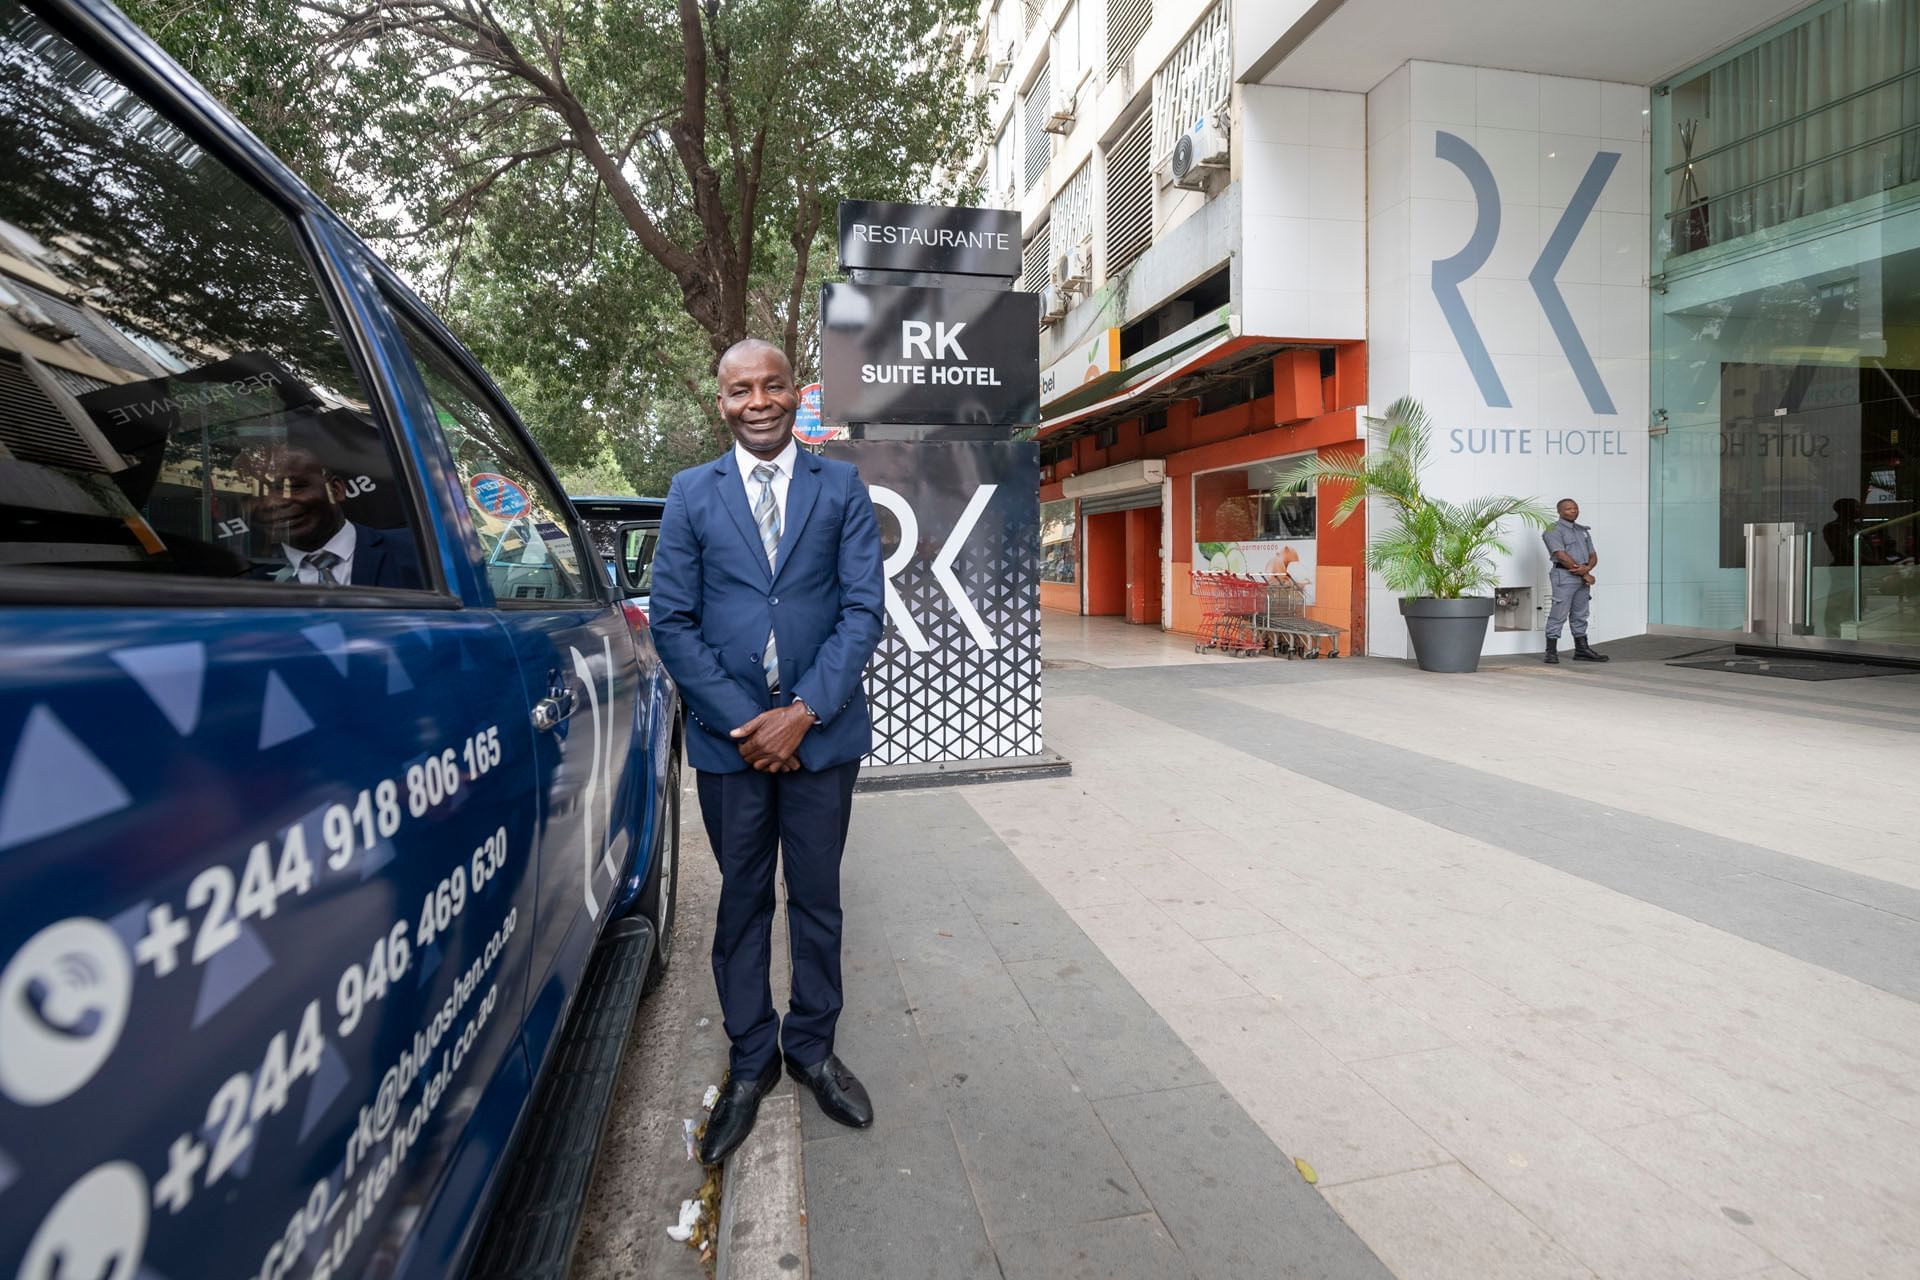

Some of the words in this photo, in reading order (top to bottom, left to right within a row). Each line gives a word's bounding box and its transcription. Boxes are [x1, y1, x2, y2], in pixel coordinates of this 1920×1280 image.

[852, 223, 1009, 250] RESTAURANTE
[1430, 129, 1623, 415] RK
[902, 319, 968, 361] RK
[861, 364, 926, 384] SUITE
[931, 366, 1001, 386] HOTEL
[1040, 371, 1055, 395] bel
[1450, 428, 1533, 454] SUITE
[1546, 430, 1627, 455] HOTEL
[868, 484, 999, 652] RK
[134, 822, 313, 978] +244
[322, 778, 402, 872] 918
[406, 747, 460, 818] 806
[463, 725, 501, 781] 165
[153, 998, 325, 1214] +244
[336, 918, 411, 1038] 946
[416, 865, 467, 948] 469
[471, 826, 507, 894] 630
